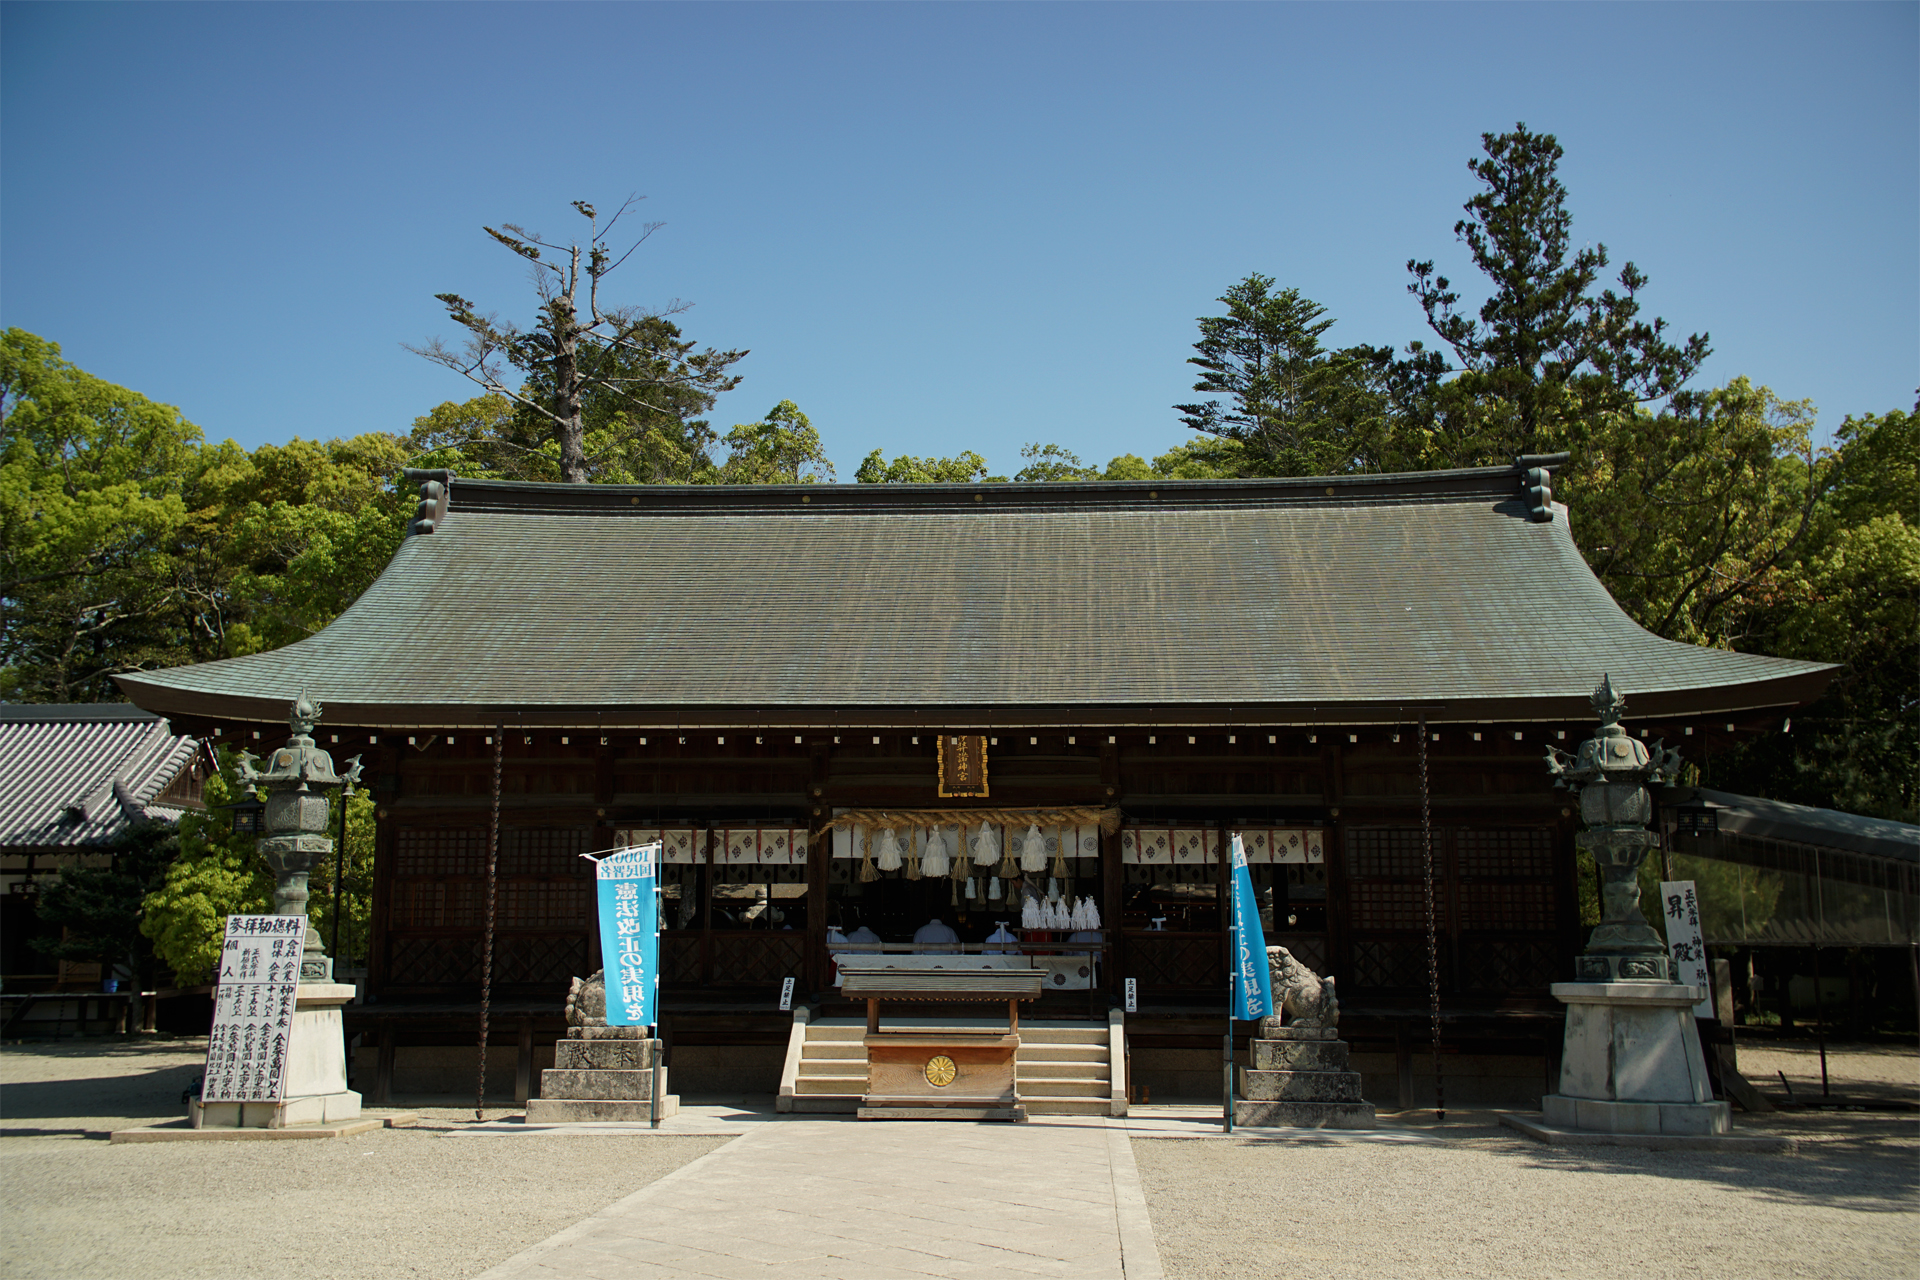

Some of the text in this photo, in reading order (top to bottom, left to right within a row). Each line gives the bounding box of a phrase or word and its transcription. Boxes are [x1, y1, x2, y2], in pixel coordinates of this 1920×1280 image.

[1666, 894, 1695, 962] 昇殿
[222, 939, 239, 978] 個人
[782, 978, 793, 1006] 土足禁止
[1127, 978, 1136, 1008] 土足禁止
